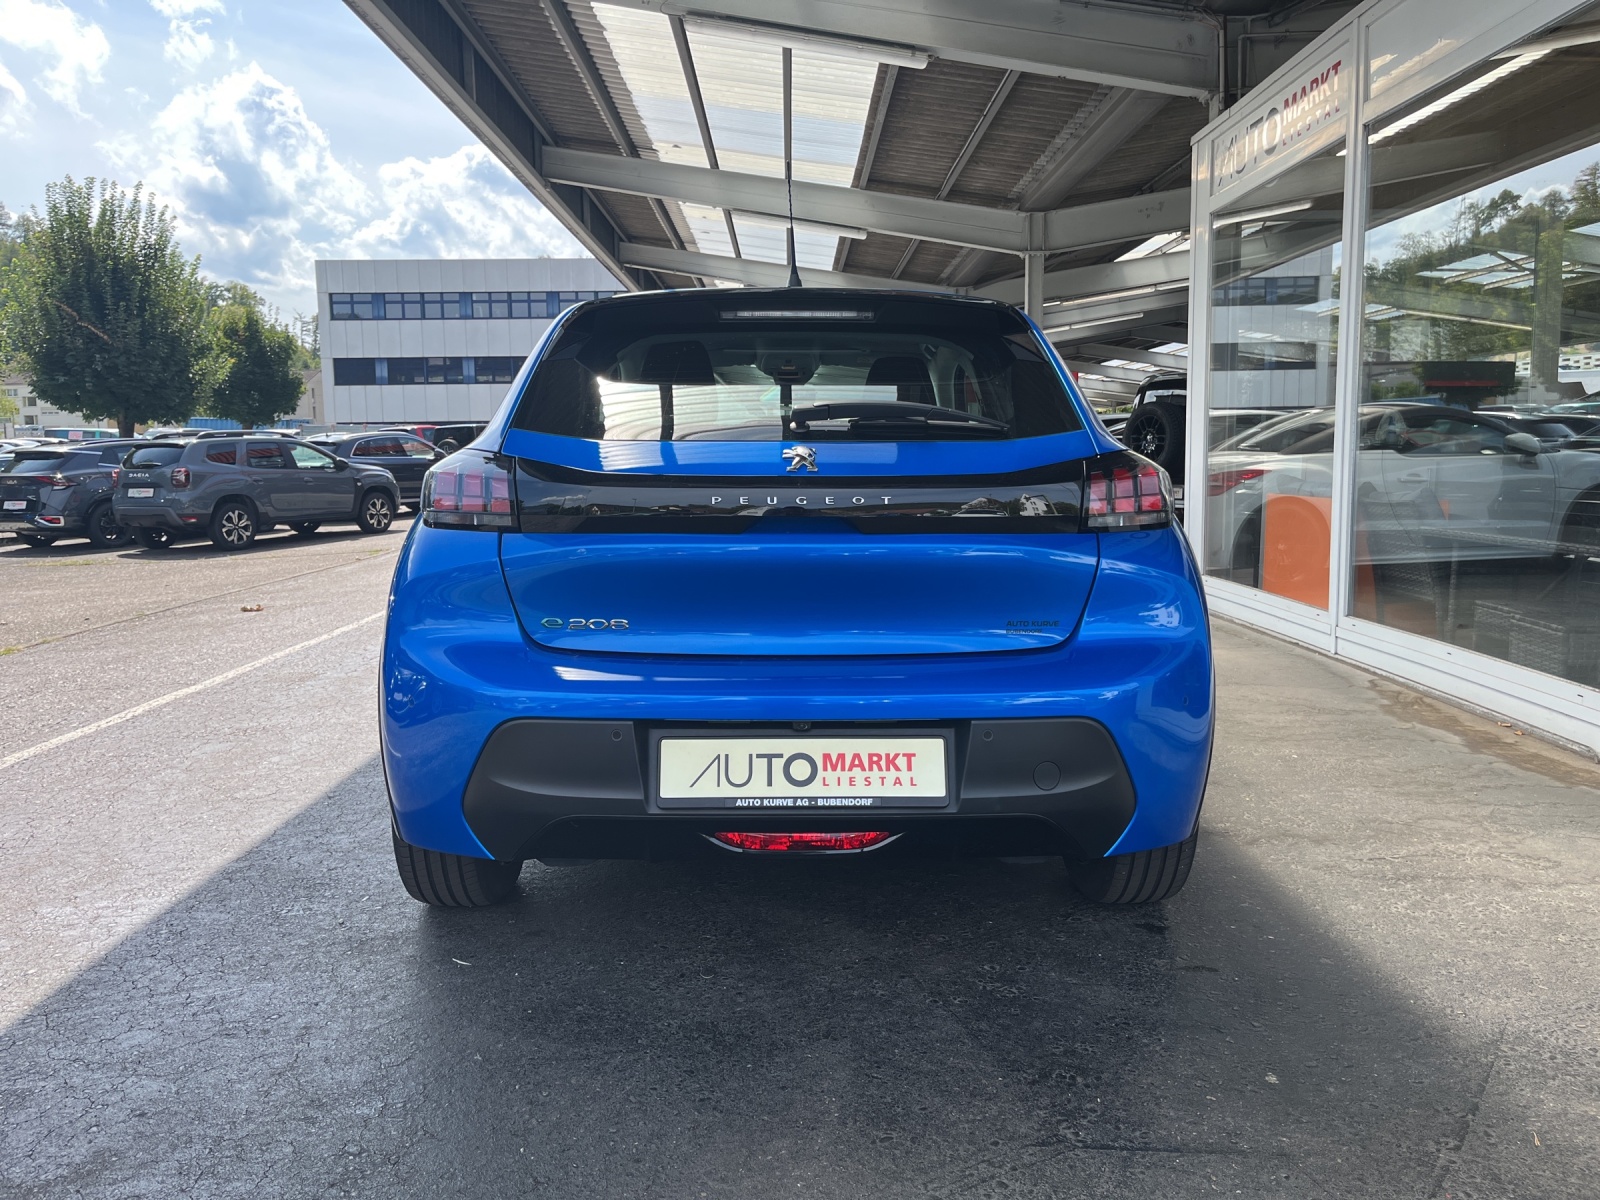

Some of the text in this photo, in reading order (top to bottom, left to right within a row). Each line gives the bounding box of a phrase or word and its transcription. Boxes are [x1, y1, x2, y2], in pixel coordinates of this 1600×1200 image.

[1217, 59, 1342, 187] AUTO MARKT
[1282, 98, 1340, 147] LIESTAL
[711, 496, 892, 505] PEUGEOT
[689, 752, 917, 788] AUTO MARKT
[822, 776, 917, 787] LIESTAL
[735, 798, 761, 807] AUTO
[763, 798, 794, 807] KURVE
[796, 798, 809, 807] AG
[817, 798, 873, 806] BUBENDORF
